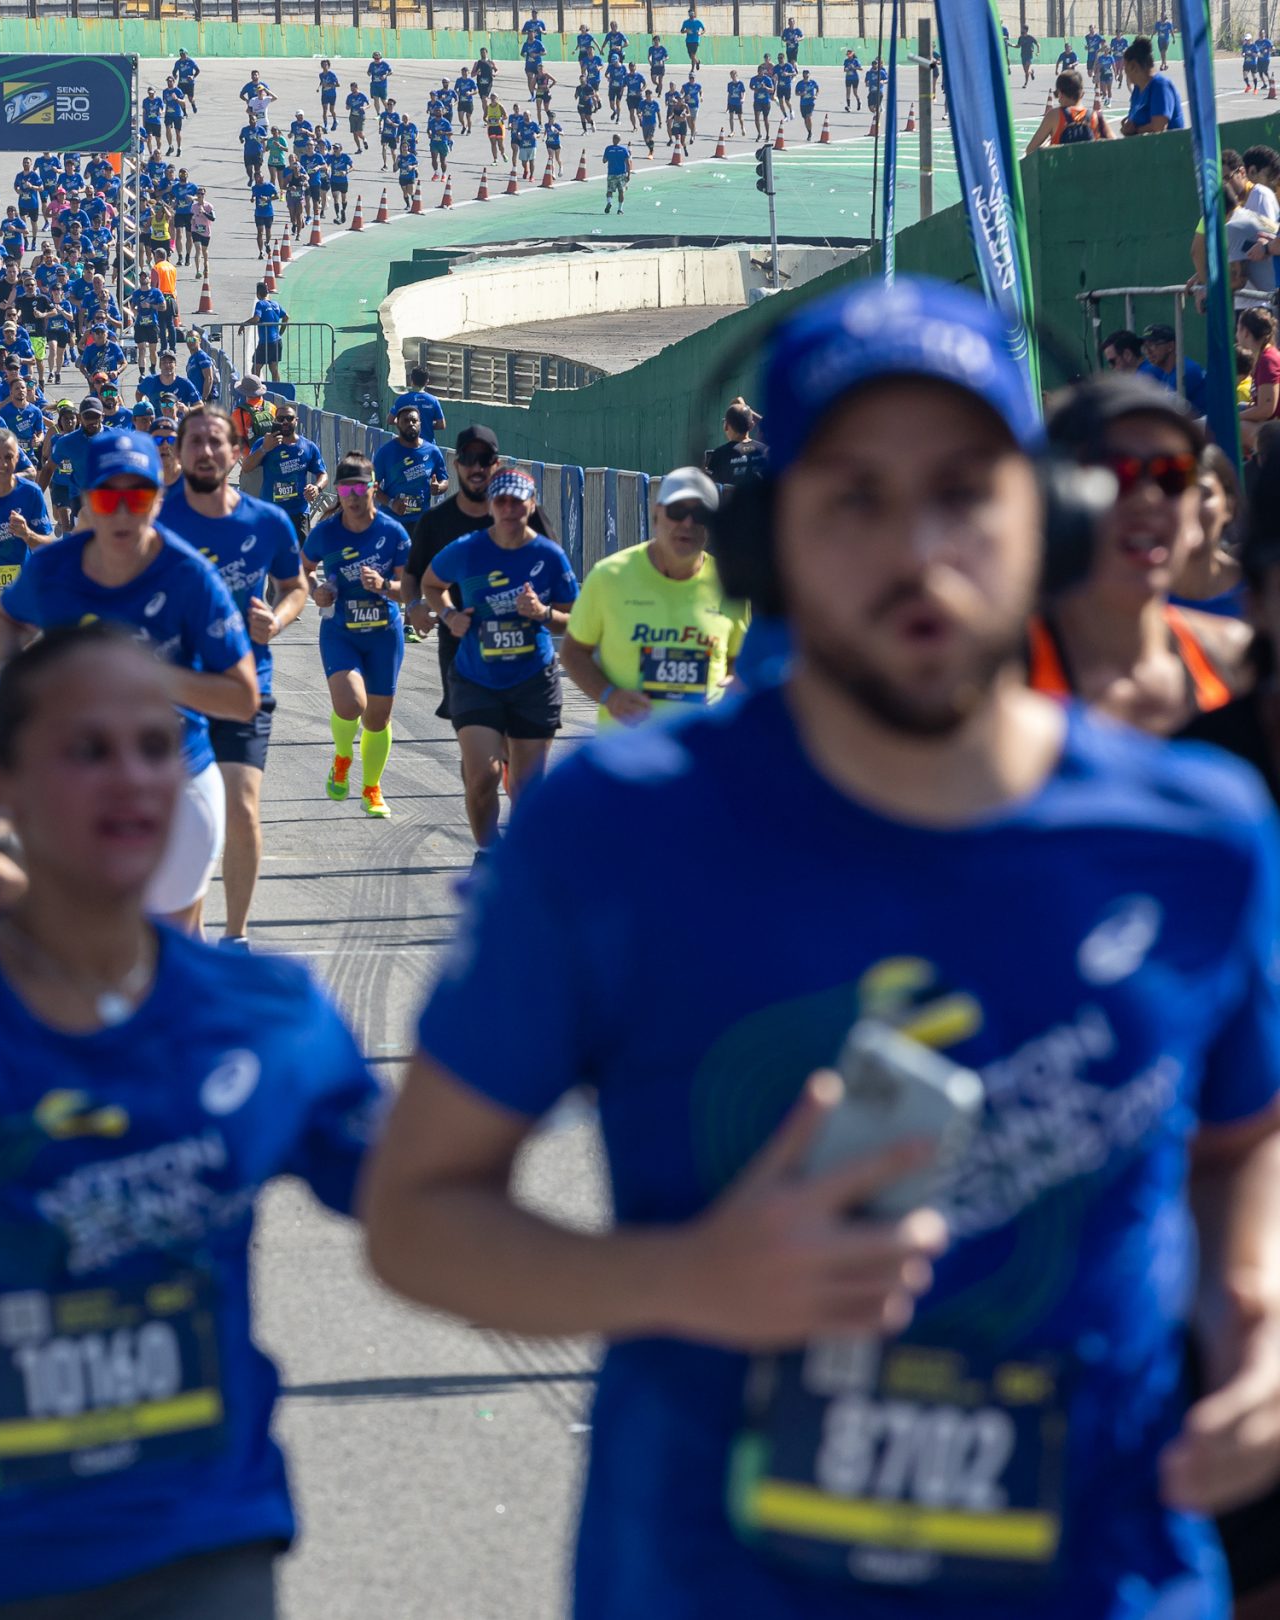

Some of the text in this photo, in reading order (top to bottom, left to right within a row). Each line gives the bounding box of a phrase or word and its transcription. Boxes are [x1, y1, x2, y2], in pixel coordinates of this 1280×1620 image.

[56, 86, 89, 94] SENNA
[56, 96, 90, 112] 30
[57, 112, 90, 121] ANOS
[972, 184, 1016, 291] AYRTON
[278, 486, 293, 495] 9037
[351, 607, 380, 622] 7440
[493, 630, 524, 648] 9513
[655, 661, 699, 683] 6385
[12, 1321, 182, 1420] 10160
[818, 1396, 1017, 1513] 8702
